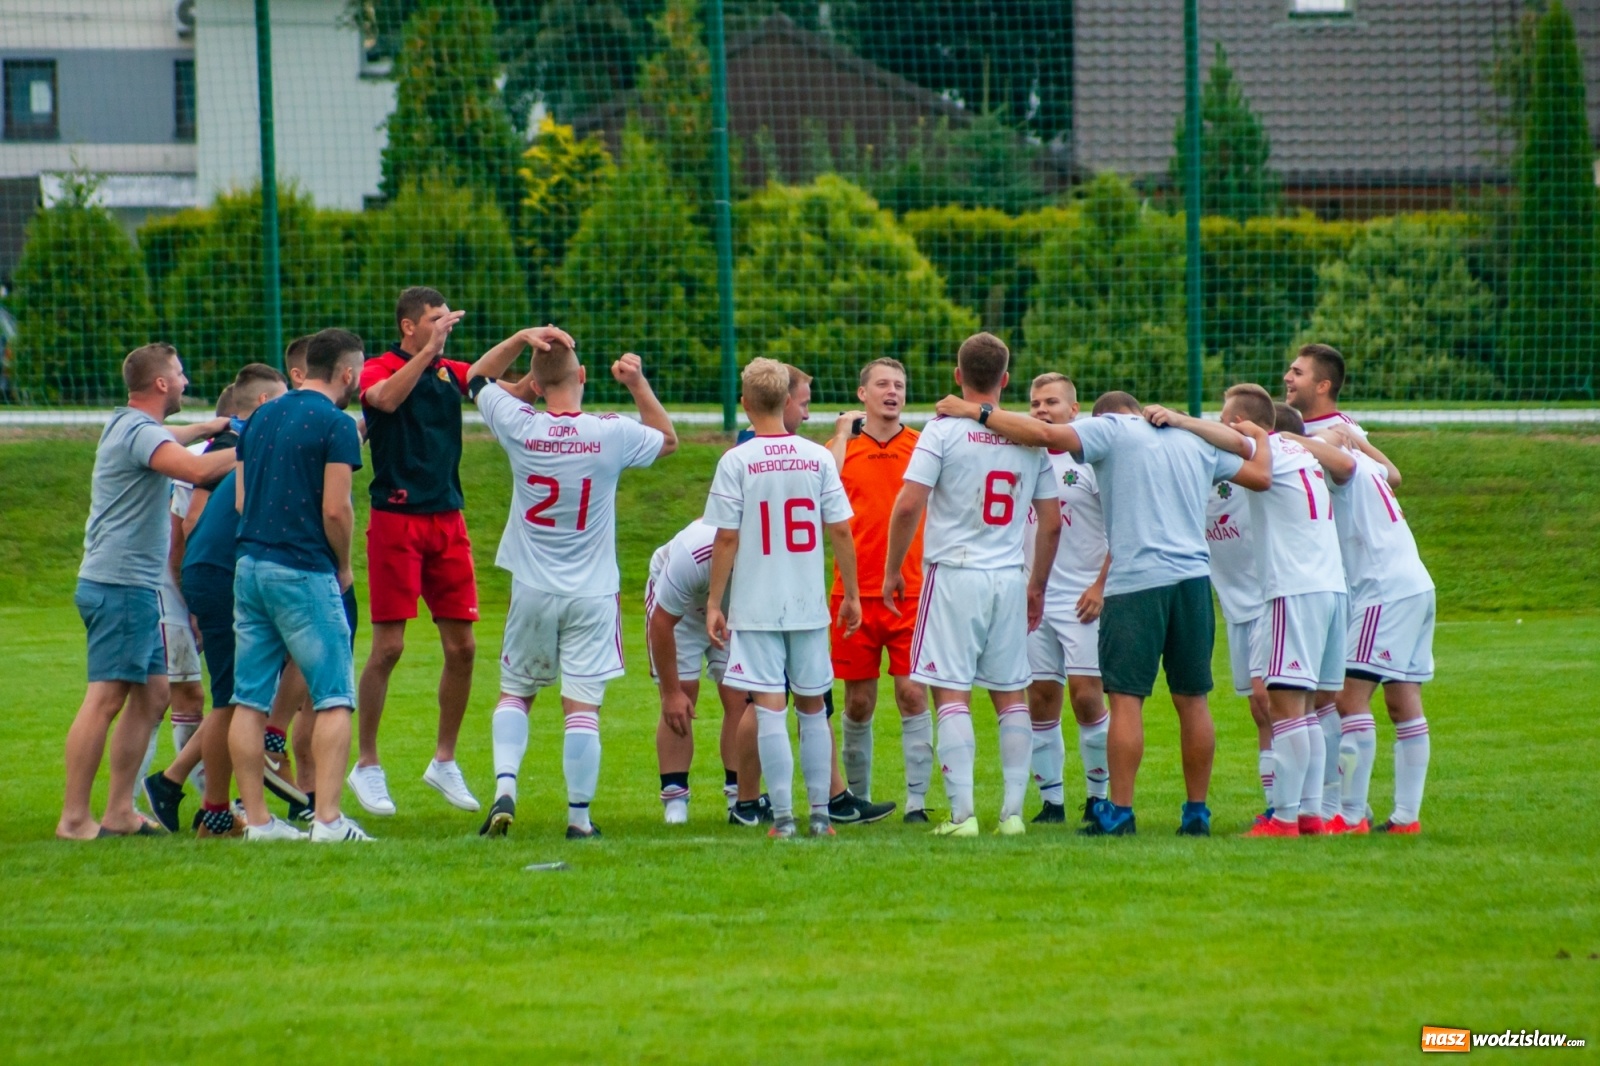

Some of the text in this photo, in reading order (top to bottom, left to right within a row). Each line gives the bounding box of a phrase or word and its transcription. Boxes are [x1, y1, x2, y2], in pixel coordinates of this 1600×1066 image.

[547, 425, 579, 438] ODRA
[967, 431, 1022, 446] NIEBOCZ
[525, 438, 601, 454] NIEBOCZOWY
[764, 444, 797, 456] ODRA
[747, 459, 820, 475] NIEBOCZOWY
[525, 474, 592, 531] 21
[983, 470, 1016, 526] 6
[759, 497, 817, 555] 16
